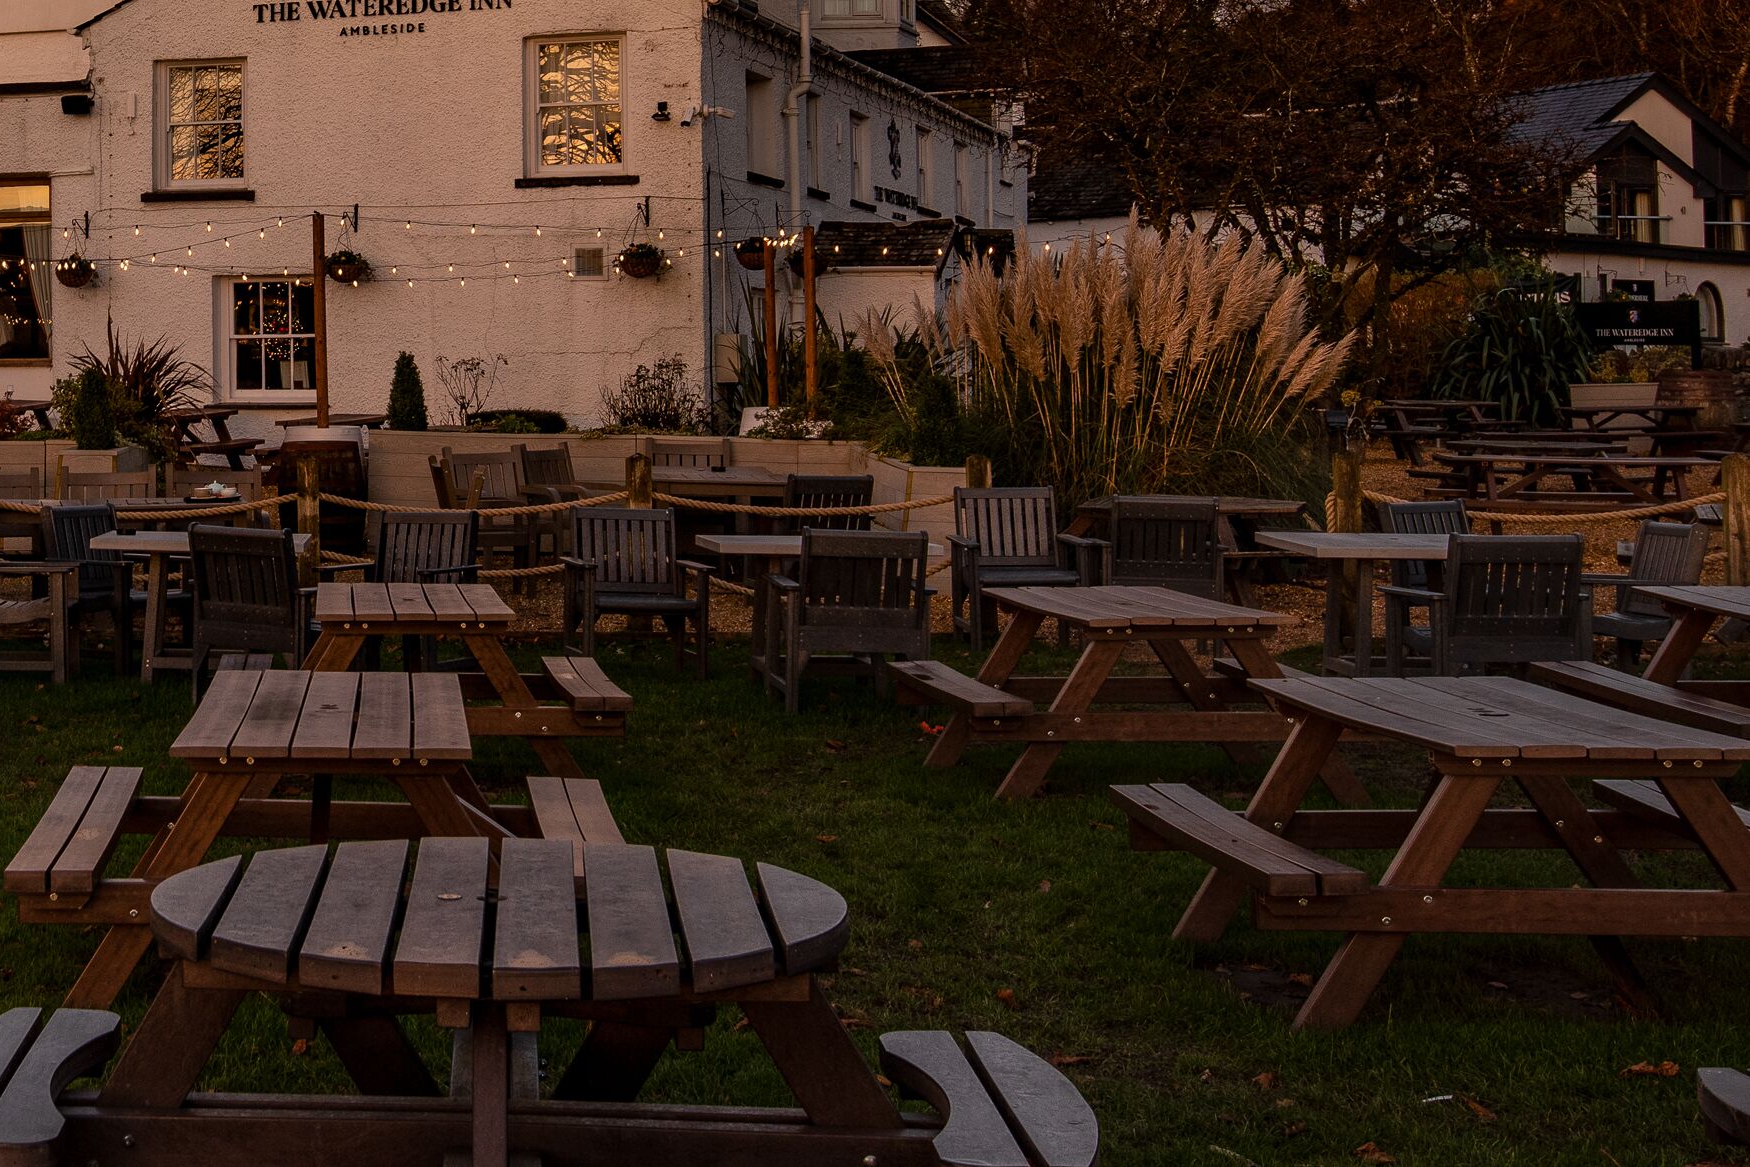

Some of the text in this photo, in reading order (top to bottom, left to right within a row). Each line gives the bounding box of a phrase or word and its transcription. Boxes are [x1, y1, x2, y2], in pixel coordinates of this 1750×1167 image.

[253, 1, 301, 24] THE
[339, 22, 426, 37] AMBLESIDE
[1595, 328, 1675, 337] THE WATEREDGE INN
